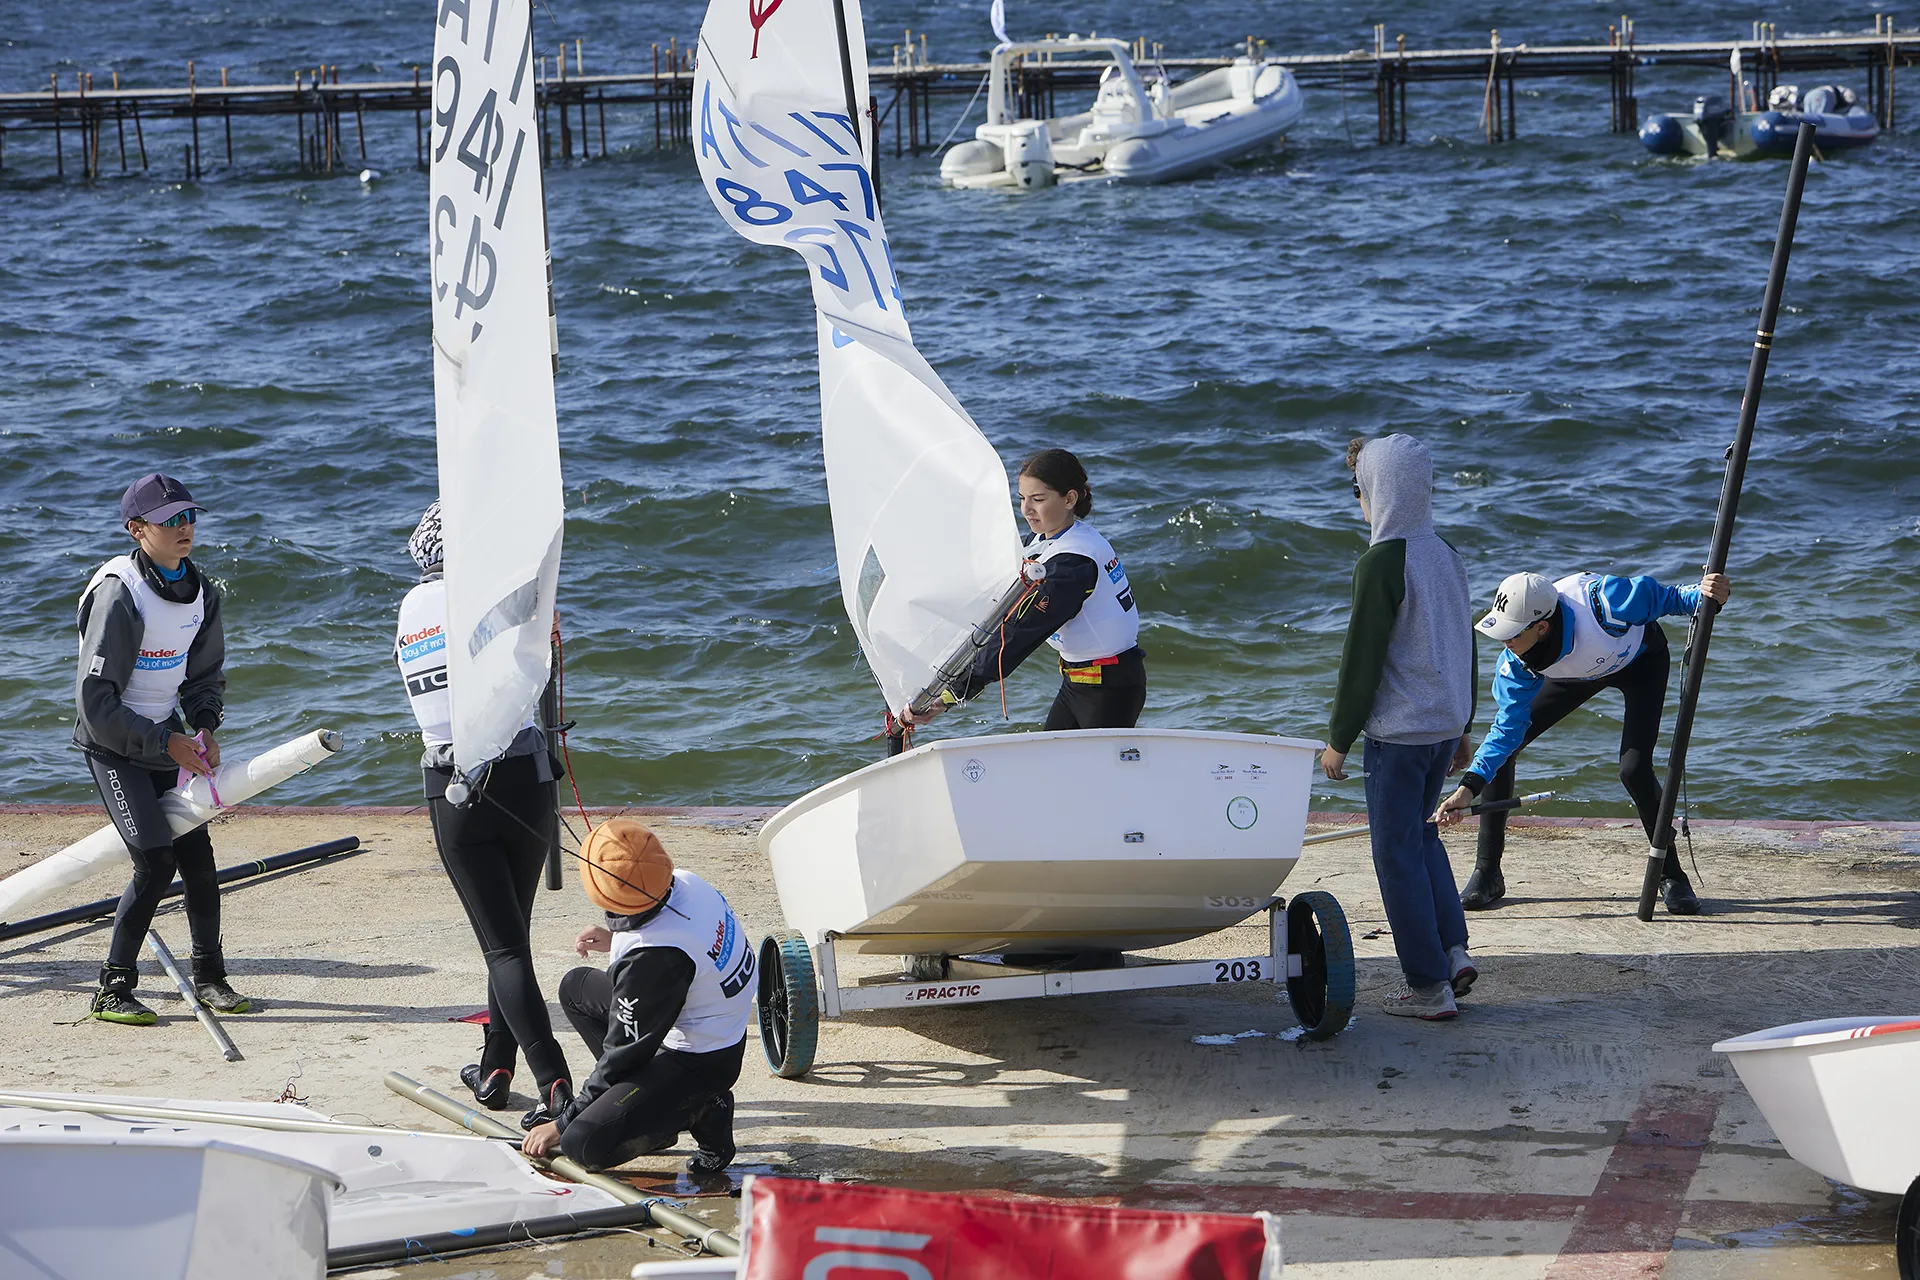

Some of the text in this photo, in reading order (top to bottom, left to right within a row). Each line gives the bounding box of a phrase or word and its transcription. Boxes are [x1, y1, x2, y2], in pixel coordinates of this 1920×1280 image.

[400, 626, 441, 648] Kinder
[404, 647, 419, 659] Joy
[420, 641, 429, 652] of
[151, 660, 160, 668] of
[107, 769, 138, 837] ROOSTER
[706, 919, 725, 961] Kinder
[1215, 960, 1262, 983] 203
[916, 984, 981, 1001] PRACTIC
